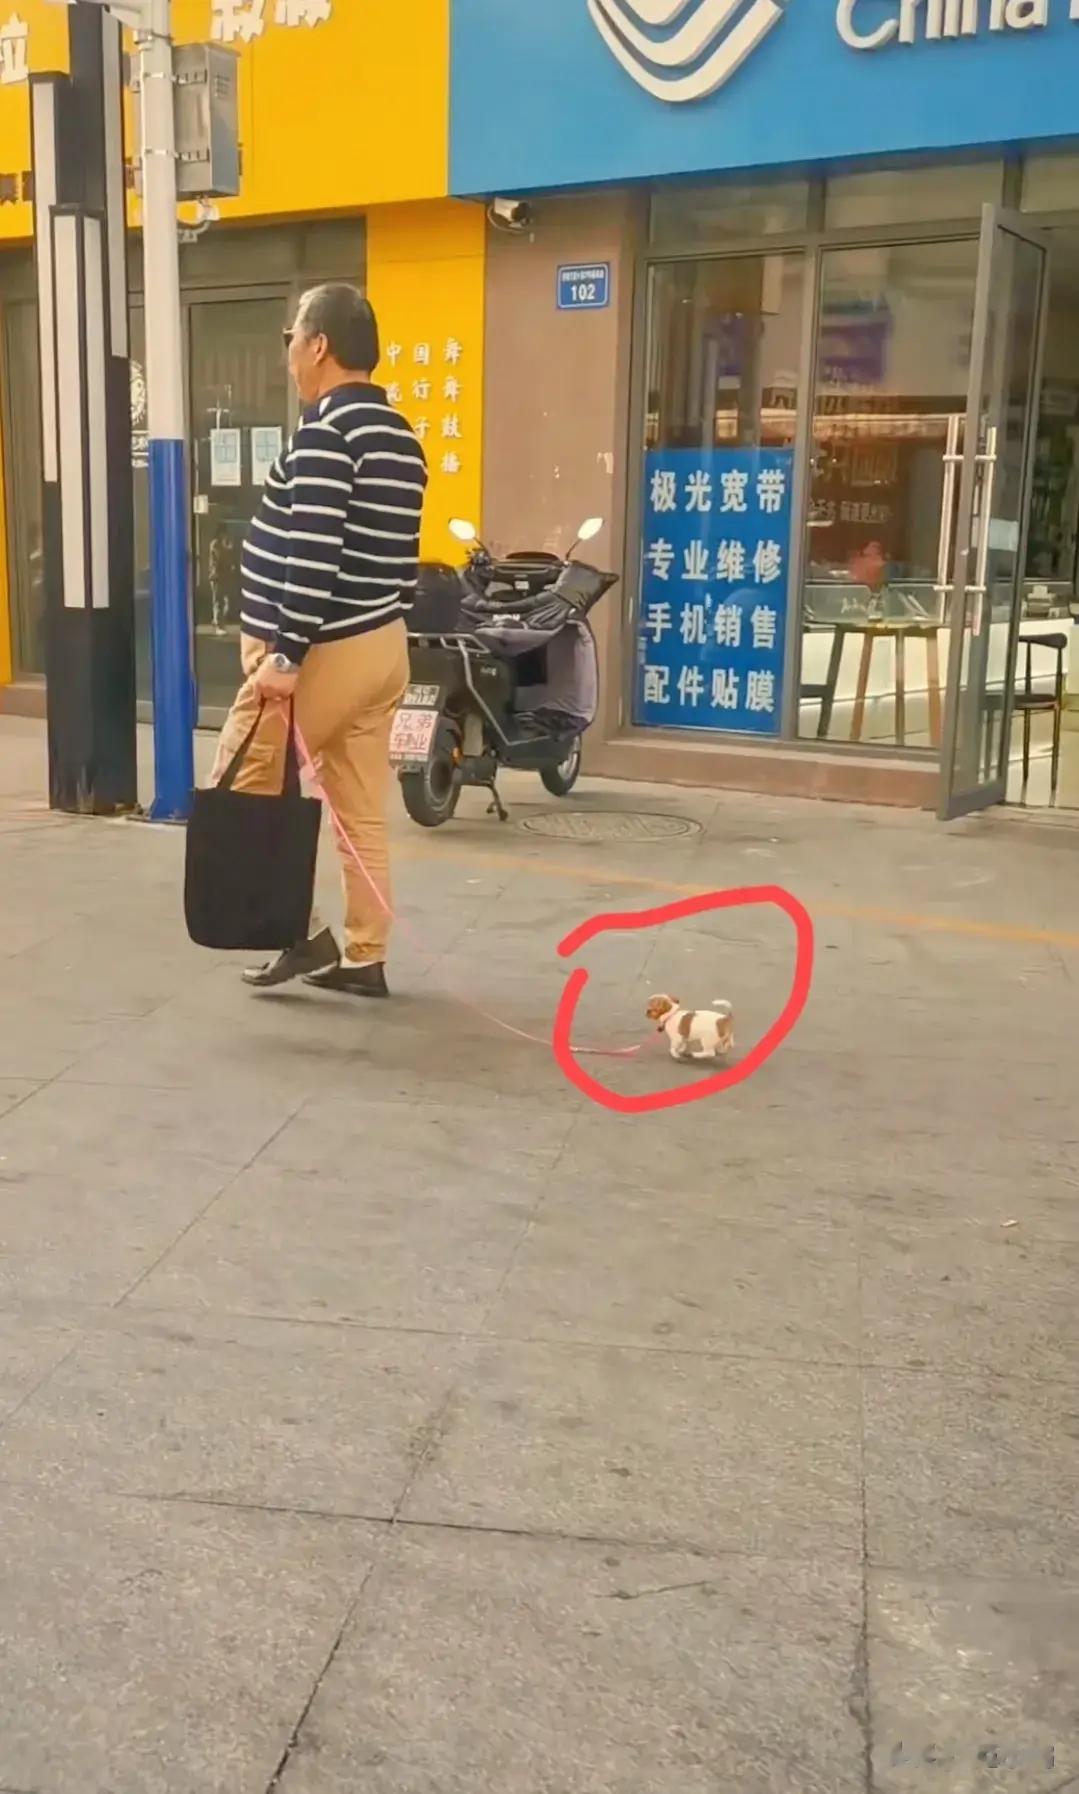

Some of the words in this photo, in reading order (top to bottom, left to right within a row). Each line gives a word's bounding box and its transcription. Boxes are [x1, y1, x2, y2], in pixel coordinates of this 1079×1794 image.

[570, 283, 595, 301] 102
[412, 412, 463, 439] 子鼓
[650, 469, 785, 513] 极光宽带
[647, 537, 782, 584] 专业维修
[645, 602, 777, 649] 手机销售
[643, 664, 775, 713] 配件贴膜
